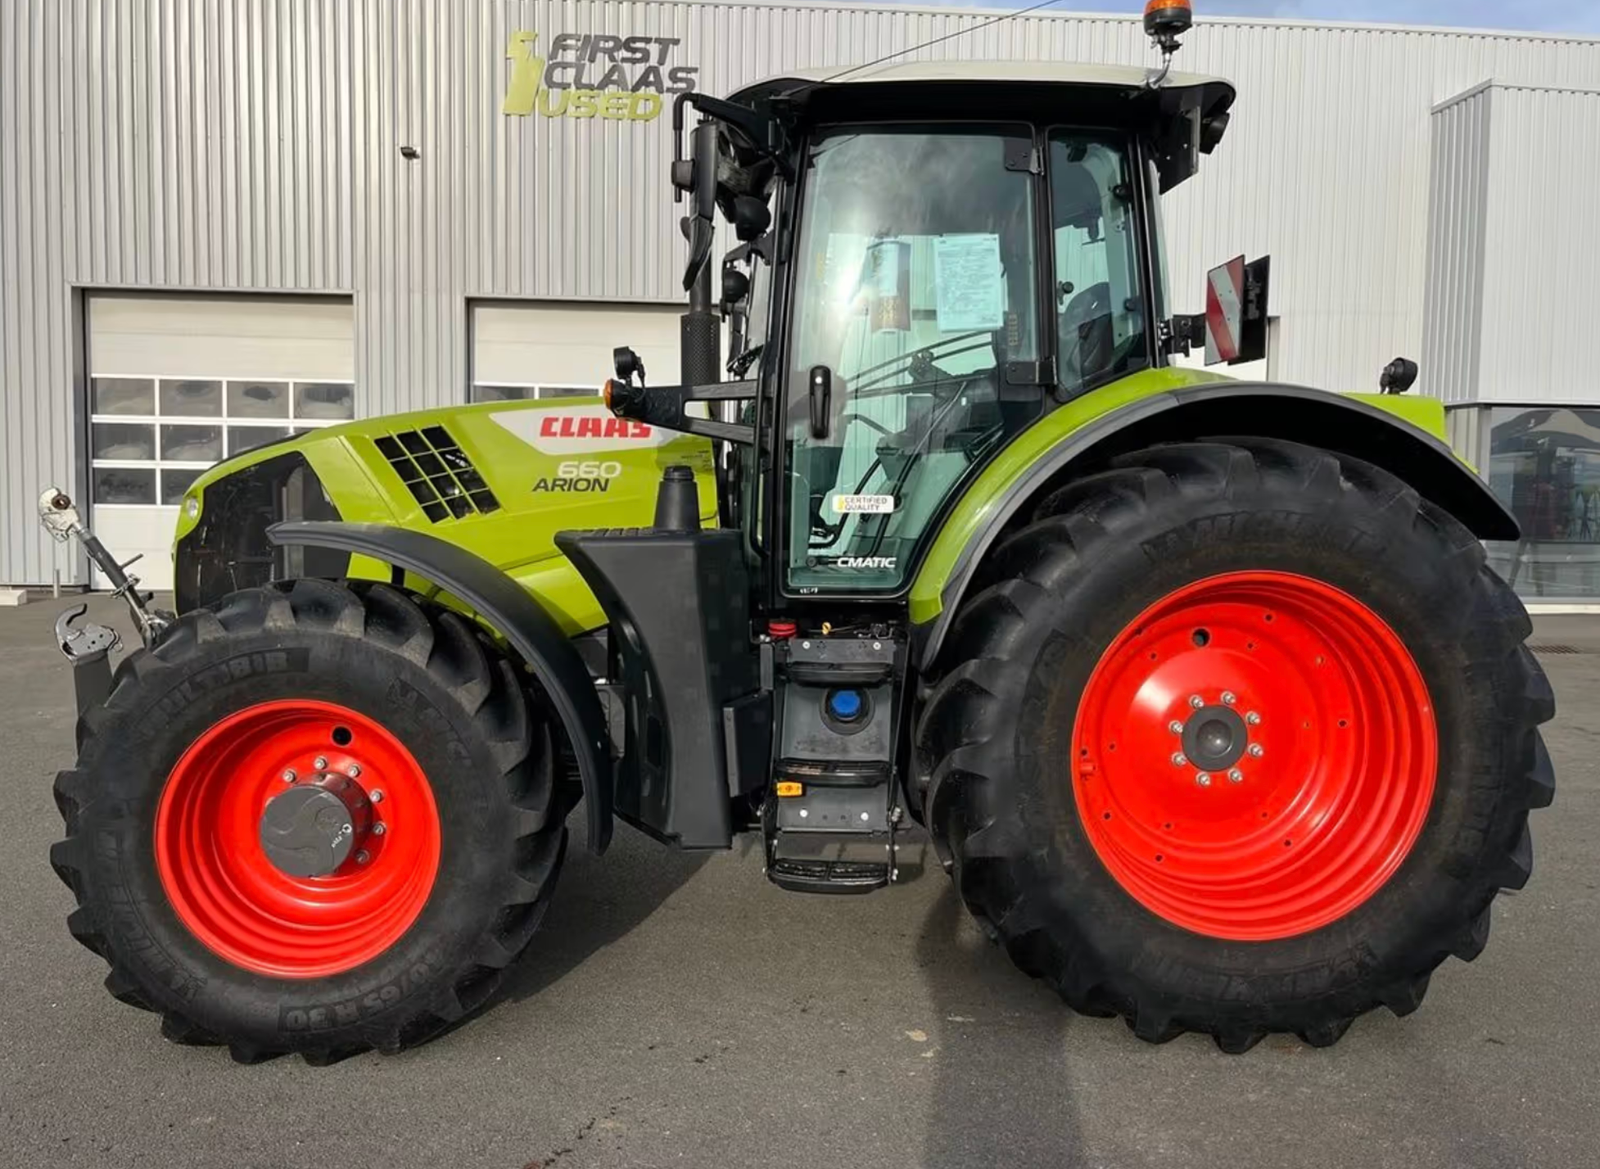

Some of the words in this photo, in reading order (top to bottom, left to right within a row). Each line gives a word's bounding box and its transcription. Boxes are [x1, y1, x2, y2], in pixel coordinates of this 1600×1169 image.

[549, 33, 681, 66] FIRST
[544, 61, 699, 94] CLAAS
[538, 88, 664, 122] USED
[540, 416, 653, 438] CLAAS
[557, 461, 622, 478] 660
[532, 478, 610, 492] ARION
[837, 557, 897, 568] CMATIC
